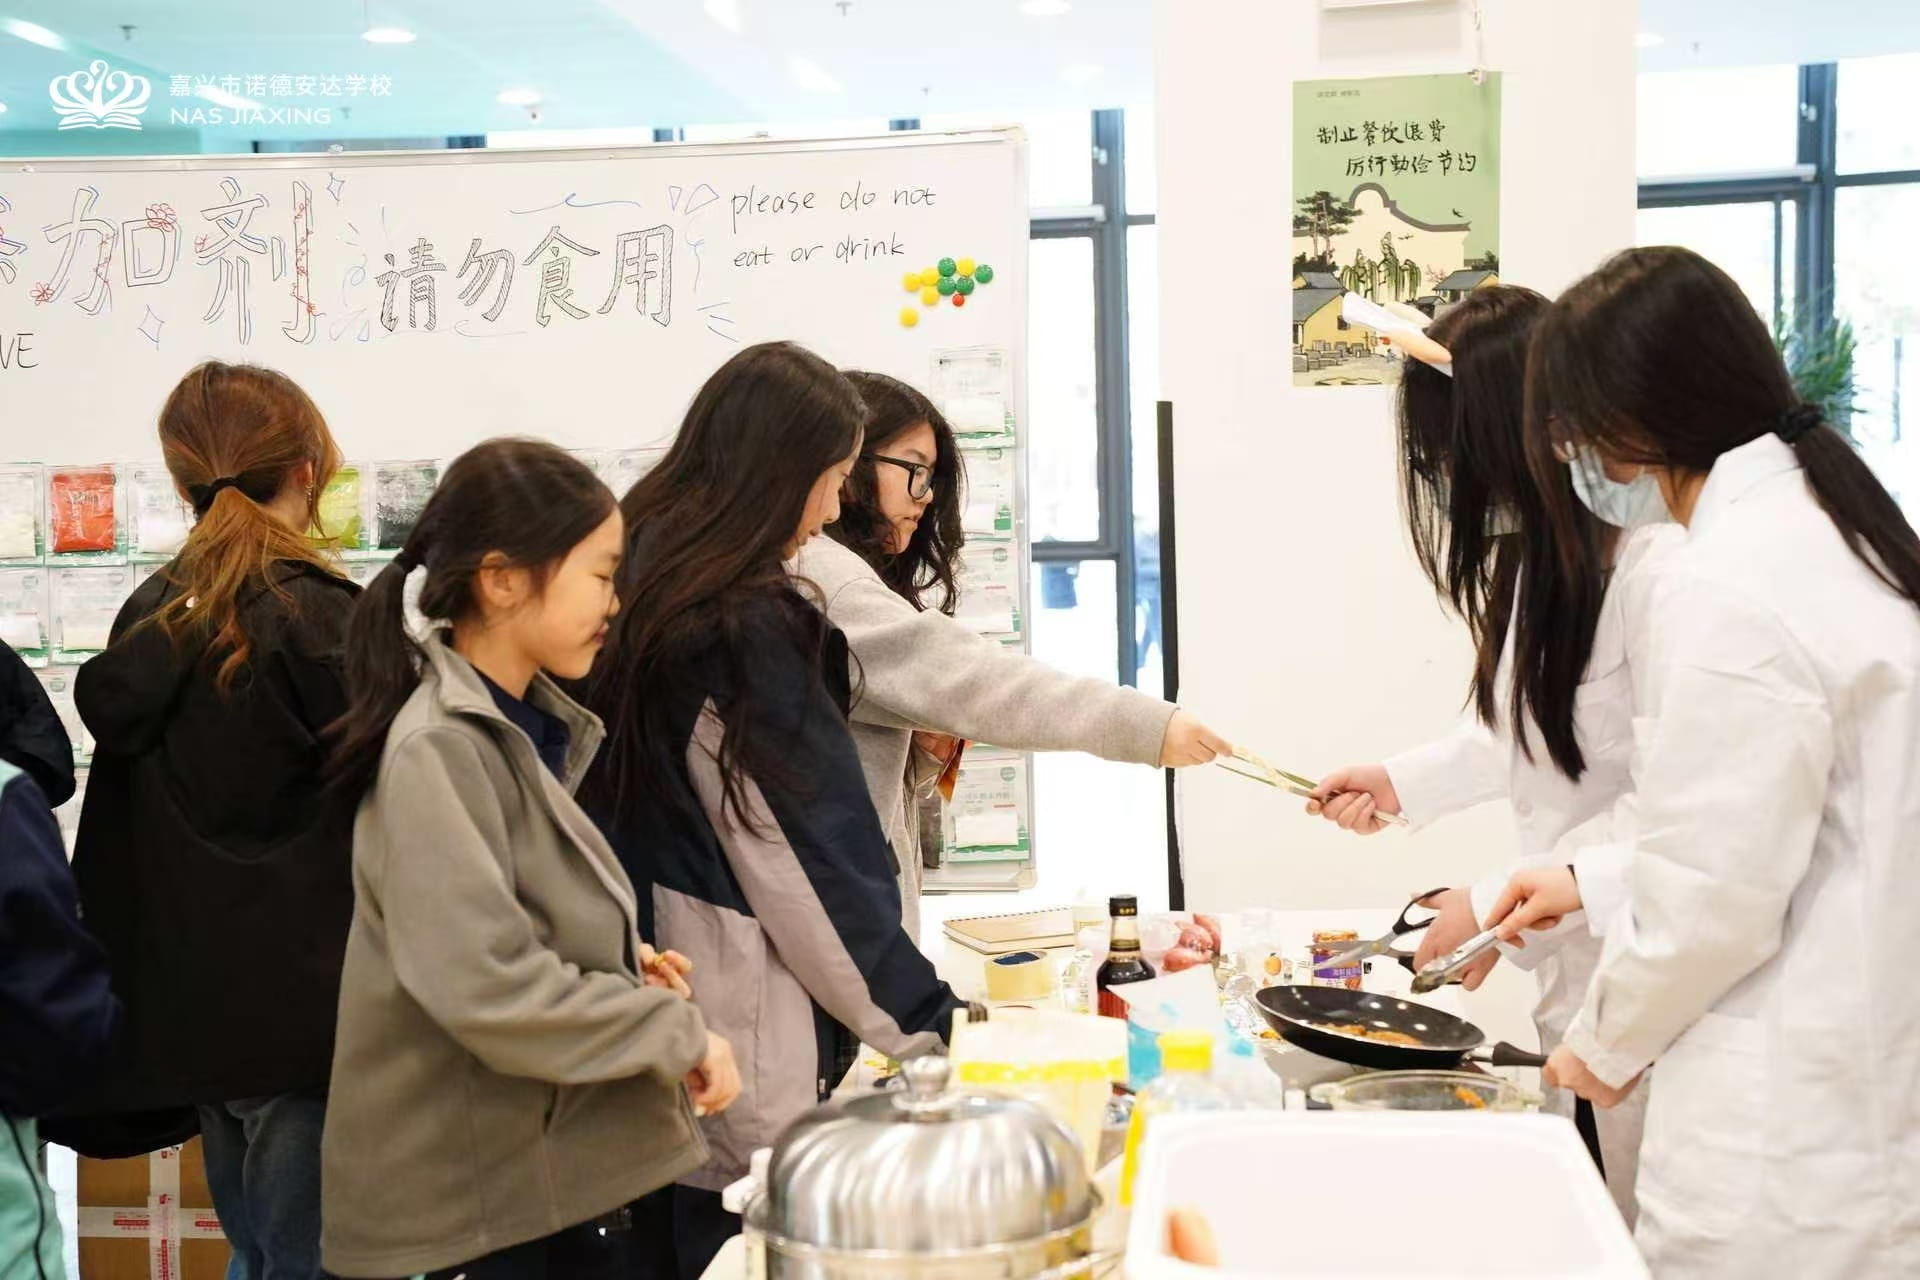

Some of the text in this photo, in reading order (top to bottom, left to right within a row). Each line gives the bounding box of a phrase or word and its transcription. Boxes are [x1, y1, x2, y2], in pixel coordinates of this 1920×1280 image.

[1316, 118, 1446, 147] 制止餐饮浪费
[1345, 149, 1477, 177] 厉行勤俭节约
[731, 180, 937, 235] please do not
[733, 231, 905, 267] eat or drink
[374, 223, 674, 332] 请勿食用
